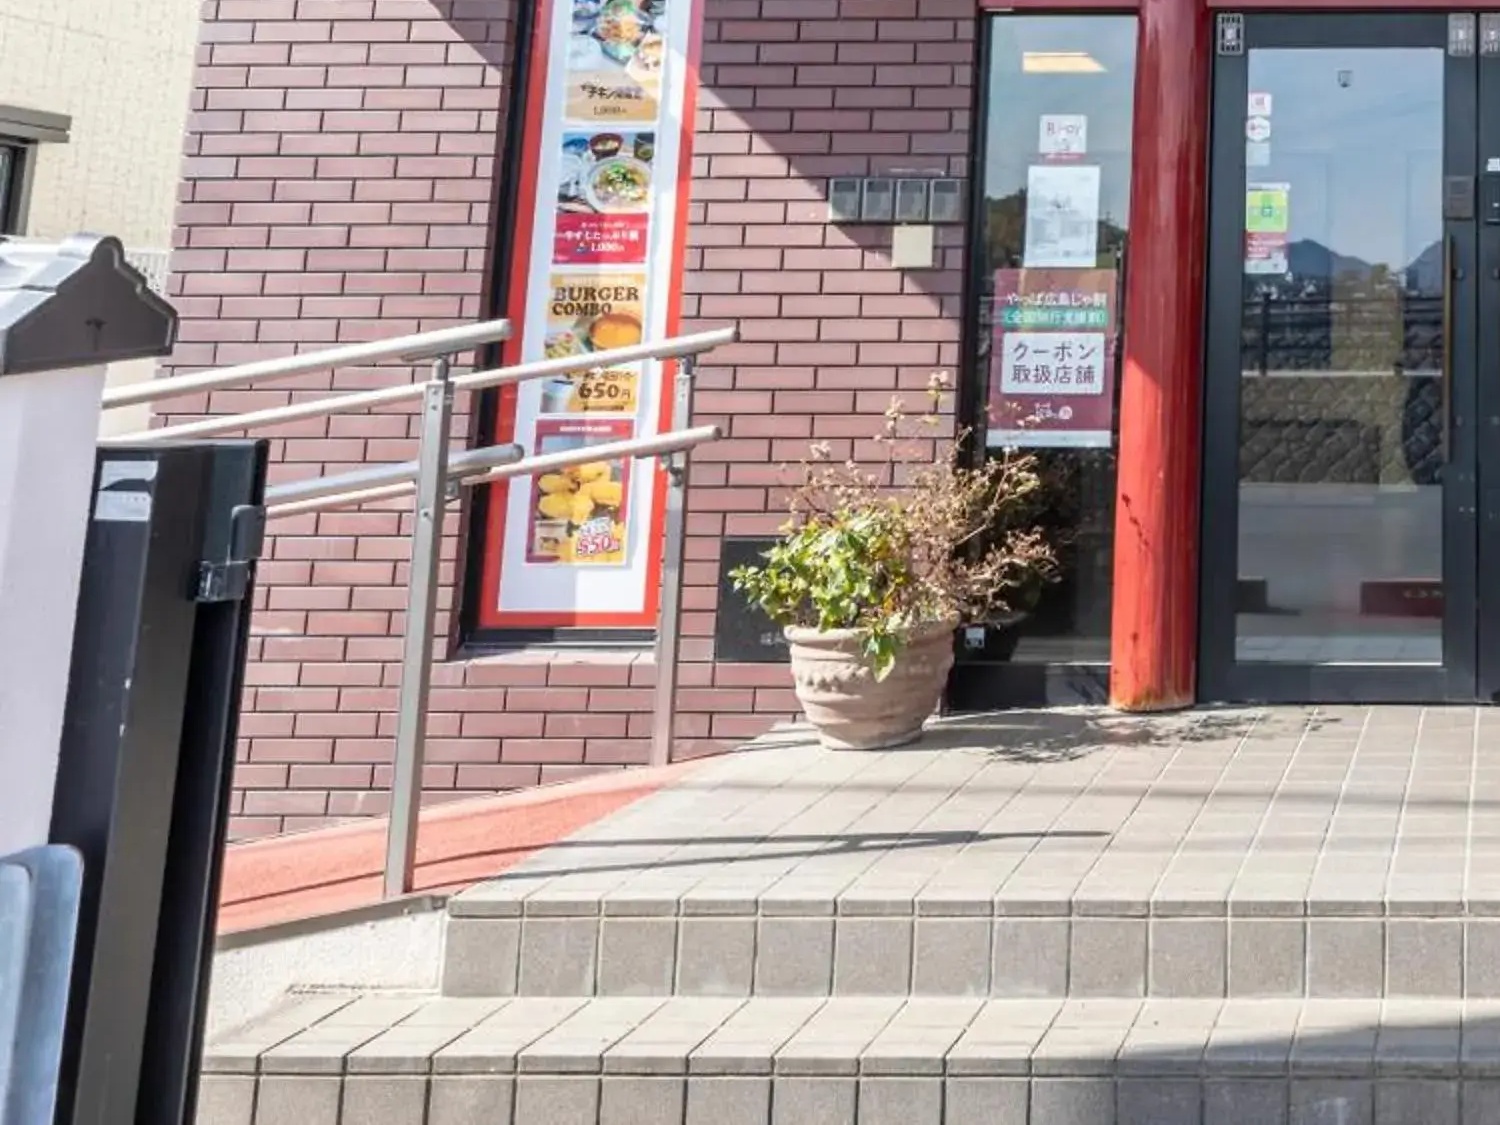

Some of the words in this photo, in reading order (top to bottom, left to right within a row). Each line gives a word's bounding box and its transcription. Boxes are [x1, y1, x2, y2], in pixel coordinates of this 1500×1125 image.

[553, 286, 639, 302] BURGER
[552, 302, 612, 316] COMBO
[1014, 341, 1097, 362] クーポン
[1011, 363, 1095, 384] 取扱店舗
[579, 382, 631, 399] 650円
